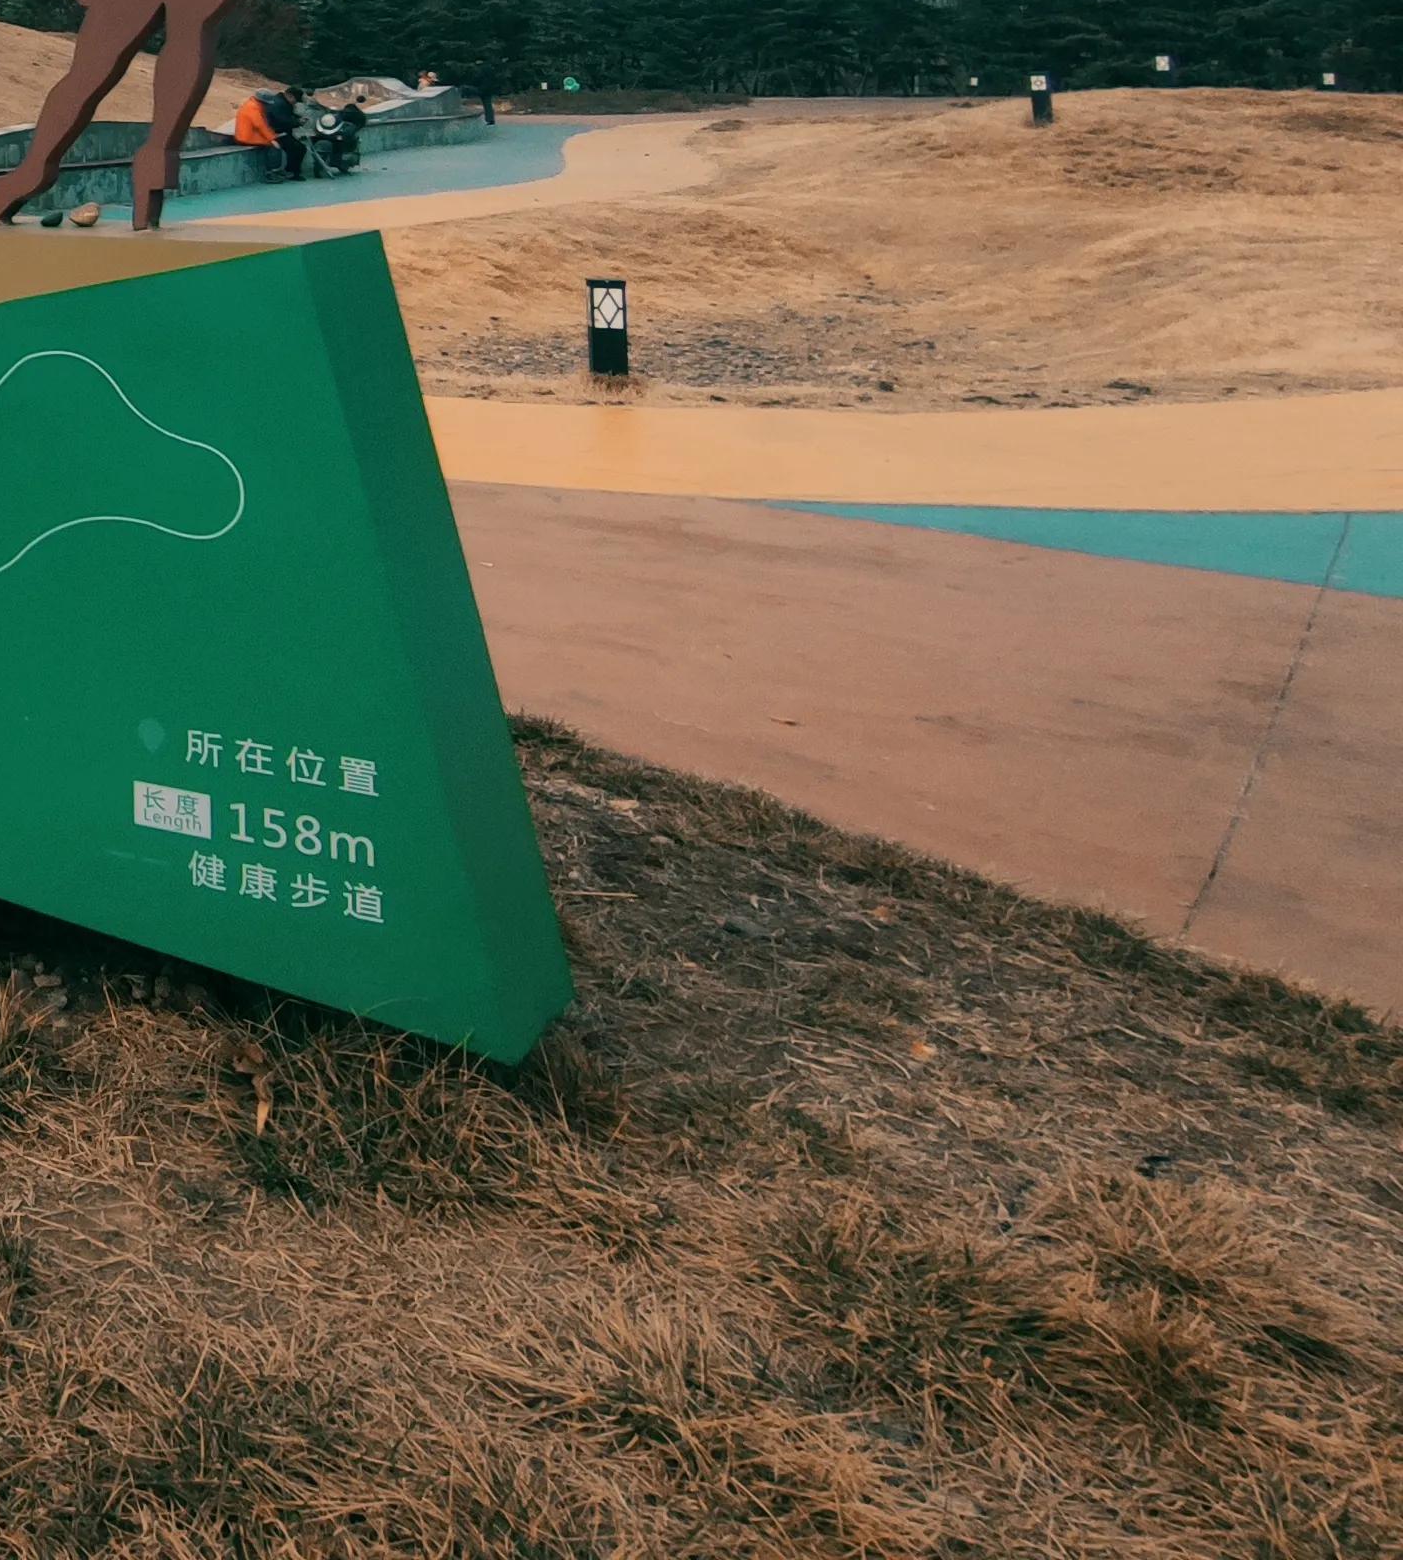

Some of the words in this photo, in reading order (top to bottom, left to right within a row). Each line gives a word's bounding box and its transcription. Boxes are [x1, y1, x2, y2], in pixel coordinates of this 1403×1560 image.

[185, 729, 380, 798] 所在位置
[142, 786, 200, 818] 长度
[143, 807, 203, 833] Length
[229, 802, 376, 868] 158m
[188, 850, 385, 924] 健康步道
